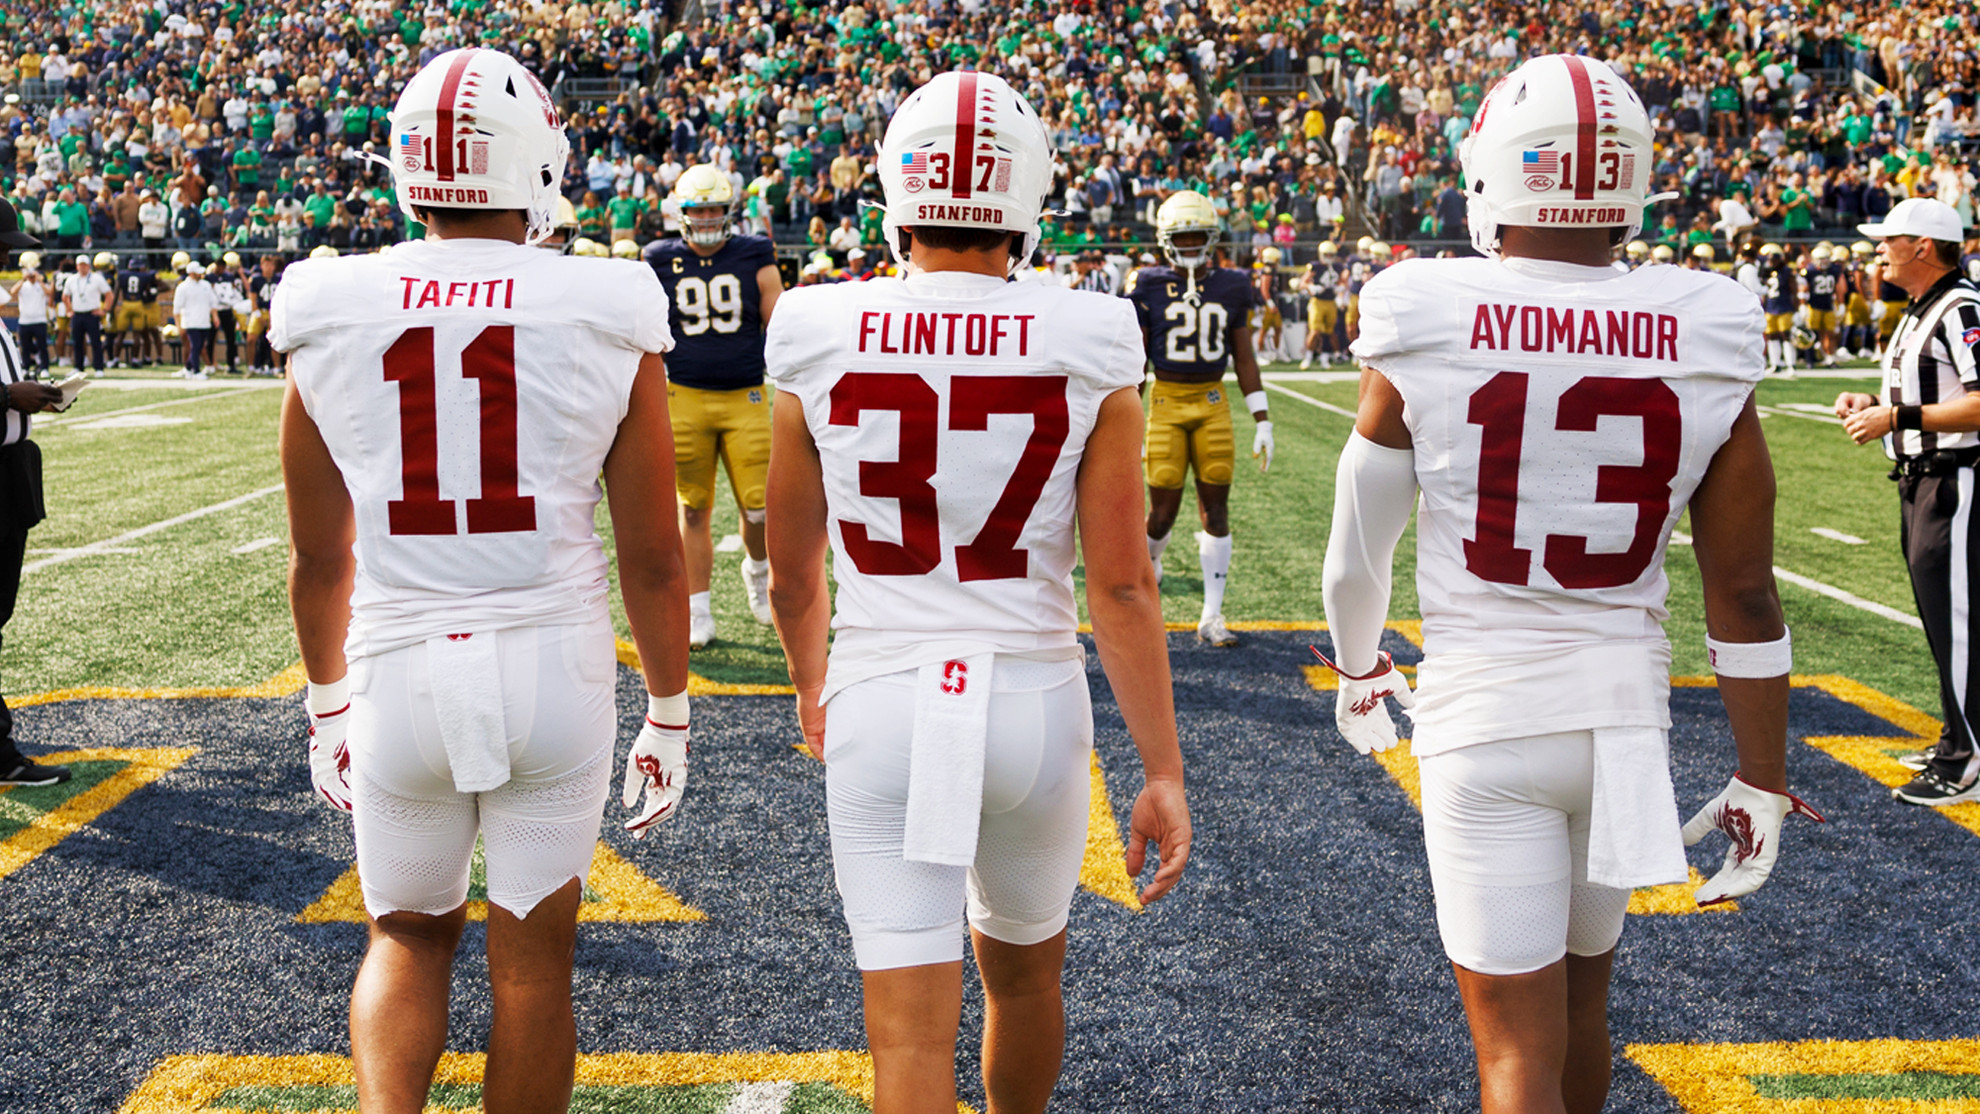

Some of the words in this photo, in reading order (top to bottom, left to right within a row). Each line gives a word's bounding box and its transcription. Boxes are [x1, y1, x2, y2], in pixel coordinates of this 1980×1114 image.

[408, 185, 489, 204] STANFORD
[918, 204, 1003, 225] STANFORD
[1537, 207, 1626, 224] STANFORD
[672, 257, 684, 274] C
[1814, 274, 1835, 294] 20
[400, 276, 514, 310] TAFITI
[675, 273, 743, 337] 99
[1166, 282, 1179, 298] C
[858, 311, 1036, 358] FLINTOFT
[1165, 301, 1228, 363] 20
[1469, 303, 1679, 363] AYOMANOR
[382, 325, 538, 536] 11
[828, 371, 1069, 583] 37
[1462, 371, 1682, 590] 13
